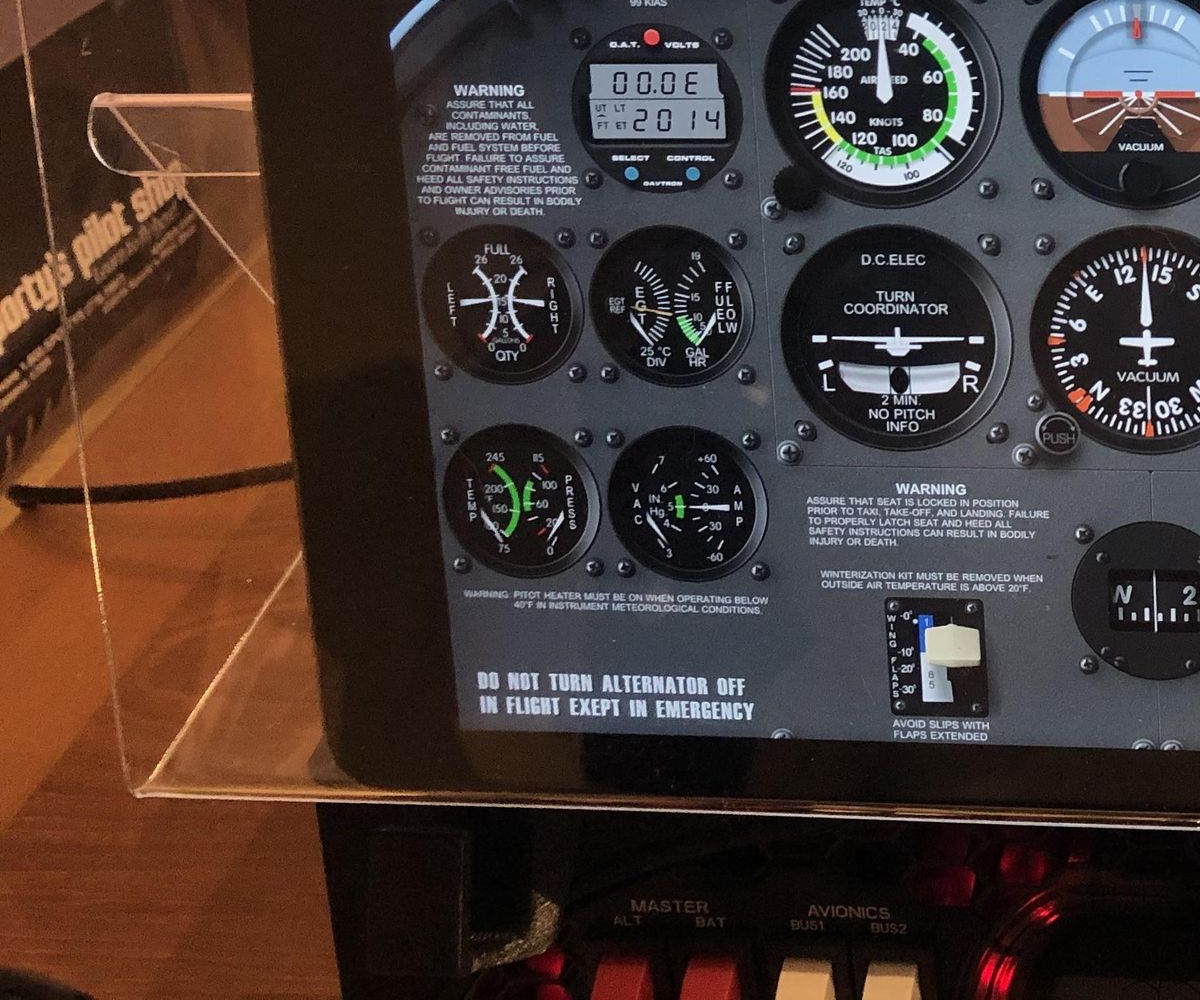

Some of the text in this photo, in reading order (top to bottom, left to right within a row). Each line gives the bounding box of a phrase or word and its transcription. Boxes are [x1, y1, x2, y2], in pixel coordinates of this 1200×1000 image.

[664, 41, 700, 49] VOLTS
[898, 42, 919, 57] 40
[840, 48, 871, 62] 200
[827, 65, 853, 79] 180
[922, 70, 943, 84] 60
[860, 75, 909, 85] AIREED
[454, 85, 525, 97] WARNING
[823, 86, 848, 100] 160
[830, 111, 856, 125] 140
[922, 108, 943, 123] 80
[869, 117, 904, 127] KNOTS
[852, 132, 918, 147] 120 100
[873, 146, 892, 156] TAS
[1118, 143, 1164, 152] VACUUM
[484, 243, 511, 255] FULL
[474, 255, 523, 265] 26 26
[876, 290, 915, 302] TURN
[843, 303, 949, 315] COORDINATOR
[495, 350, 520, 362] QTY
[685, 347, 710, 358] GAL
[646, 357, 667, 367] DIV
[689, 358, 707, 367] HR
[1116, 371, 1180, 383] VACUUM
[962, 375, 980, 393] R
[881, 395, 889, 406] 2
[868, 409, 936, 420] NO PITCH
[886, 421, 920, 433] INFO
[1043, 433, 1075, 445] PUSH
[485, 452, 506, 462] 245
[484, 484, 504, 494] 200
[896, 482, 967, 496] WARNING
[807, 496, 1019, 508] ASSURE THAT SEAT IS LOCKED IN POSITION
[808, 507, 1050, 519] PRIOR TO TAXI, TAKE-OFF, AND LANDING. FAILURE
[809, 517, 1012, 528] TO PROPERLY LATCH SEAT AND HEED ALL
[809, 527, 1036, 539] SAFETY INSTRUCTIONS CAN RESULT IN BODILY
[810, 537, 898, 547] INJURY OR DEATH.
[821, 570, 1043, 583] WINTERIZATION KIT MUST BE REMOVED WHEN
[821, 580, 1031, 593] OUTSIDE AIR TEMPERATURE IS ABOVE 20°F.
[477, 671, 746, 696] DO NOT TURN ALTERNATOR OFF
[479, 695, 755, 721] IN FLIGHT EXEPT IN EMERGENCY
[892, 719, 990, 730] AVOID SLIPS WITH
[893, 730, 988, 741] FLAPS EXTENDED
[631, 899, 709, 913] MASTER
[807, 905, 891, 920] AVIONICS
[613, 915, 727, 928] ALT BAT
[790, 919, 908, 935] BUS1 BUS2
